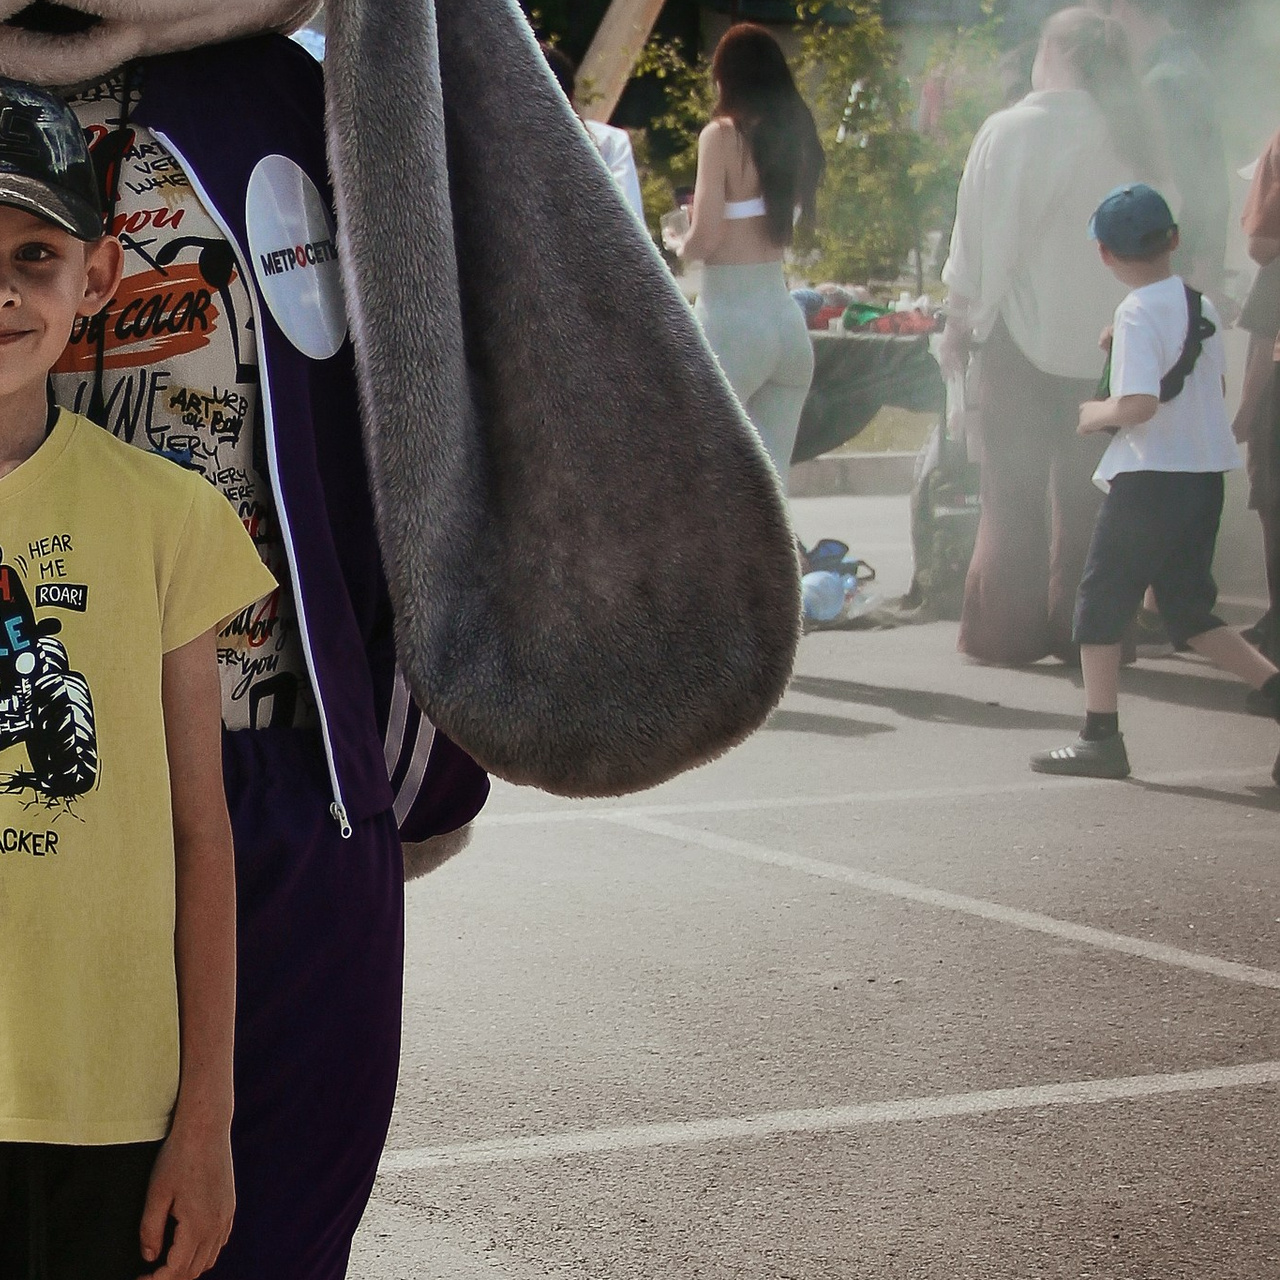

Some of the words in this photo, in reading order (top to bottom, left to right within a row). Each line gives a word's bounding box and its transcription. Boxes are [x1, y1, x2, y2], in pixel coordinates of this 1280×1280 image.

[115, 289, 211, 340] COLOR
[29, 535, 73, 560] HEAR
[40, 559, 67, 579] ME
[39, 586, 83, 606] ROAR!
